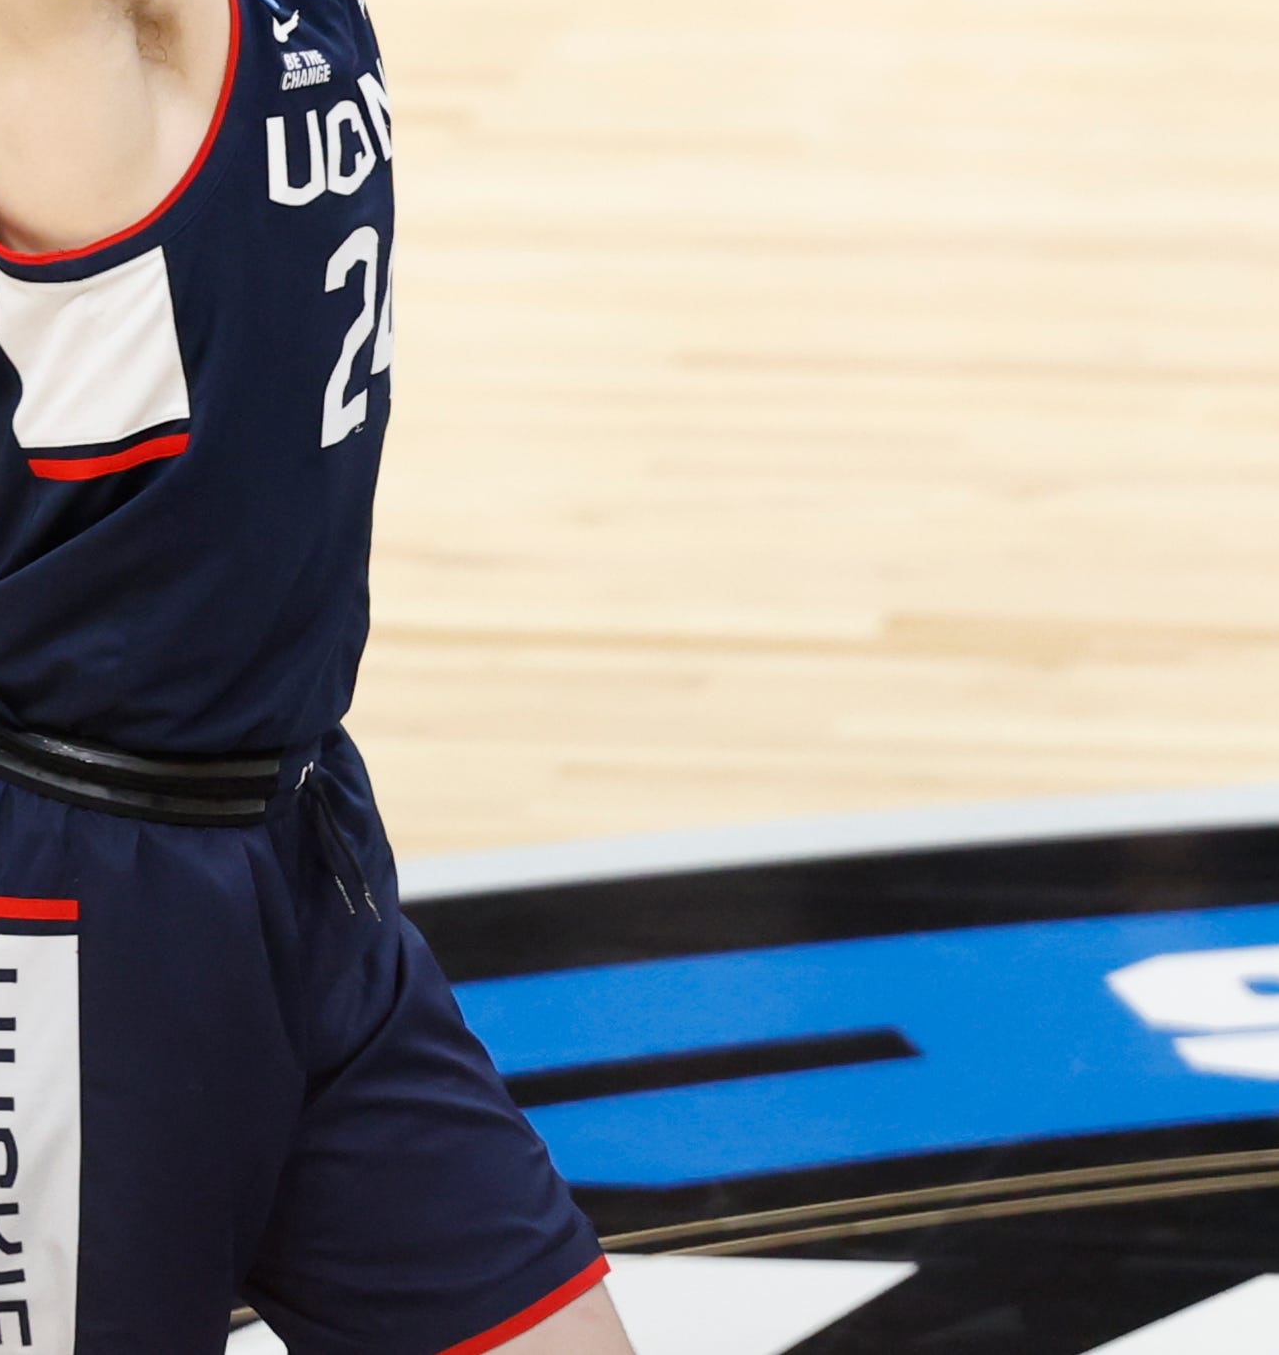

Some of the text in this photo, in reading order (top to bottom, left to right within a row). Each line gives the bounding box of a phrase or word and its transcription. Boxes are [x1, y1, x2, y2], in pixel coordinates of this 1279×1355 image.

[283, 49, 326, 71] BE THE
[282, 64, 332, 91] CHANGE
